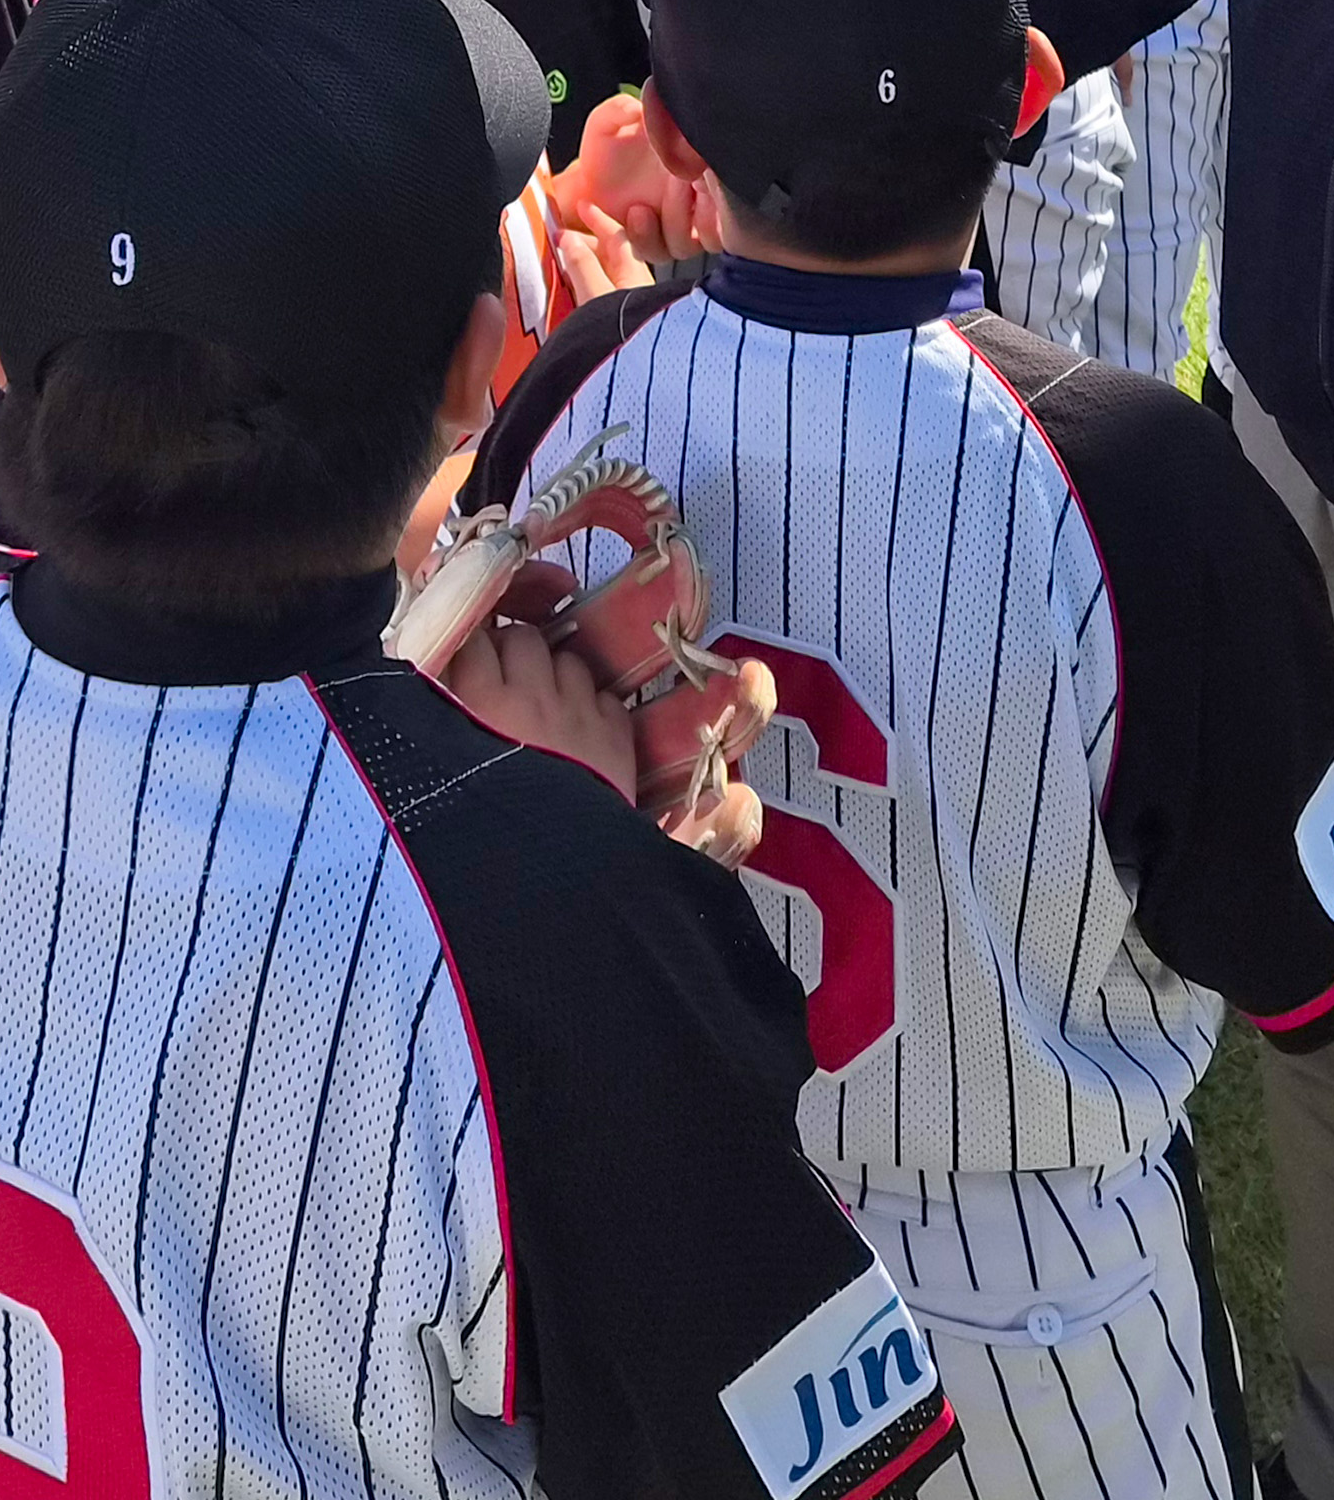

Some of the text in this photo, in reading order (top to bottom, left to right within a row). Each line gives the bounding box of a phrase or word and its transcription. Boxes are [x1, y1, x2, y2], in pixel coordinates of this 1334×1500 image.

[877, 68, 896, 104] 6
[110, 232, 136, 287] 9
[788, 1327, 929, 1483] Jin
